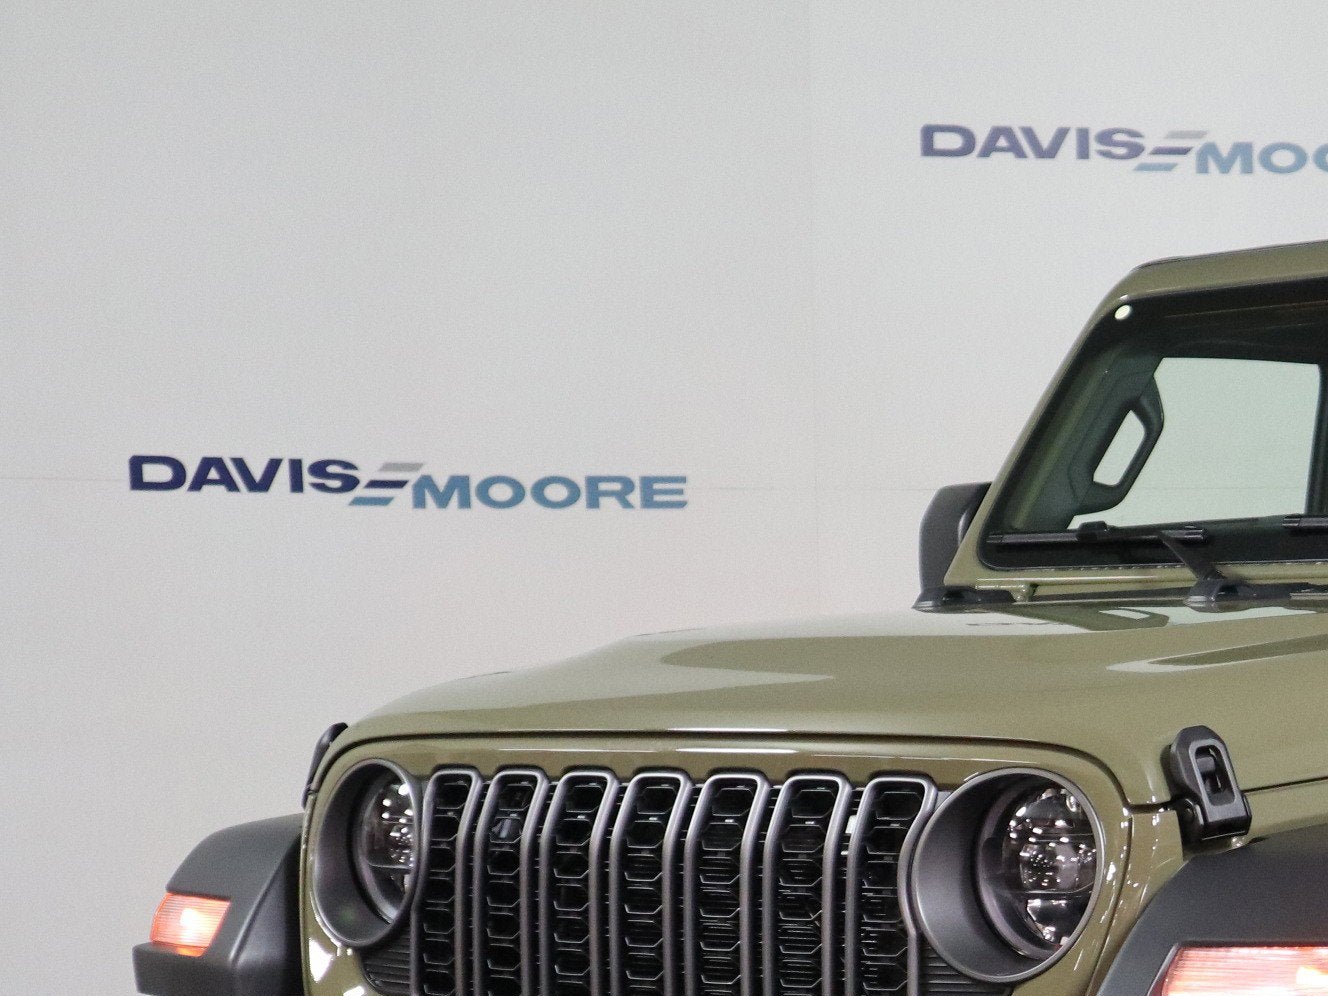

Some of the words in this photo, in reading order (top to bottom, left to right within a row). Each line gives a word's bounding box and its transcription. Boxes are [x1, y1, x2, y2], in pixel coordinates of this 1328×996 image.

[919, 123, 1146, 160] DAVIS
[128, 454, 361, 493] DAVIS
[412, 475, 688, 510] MOORE
